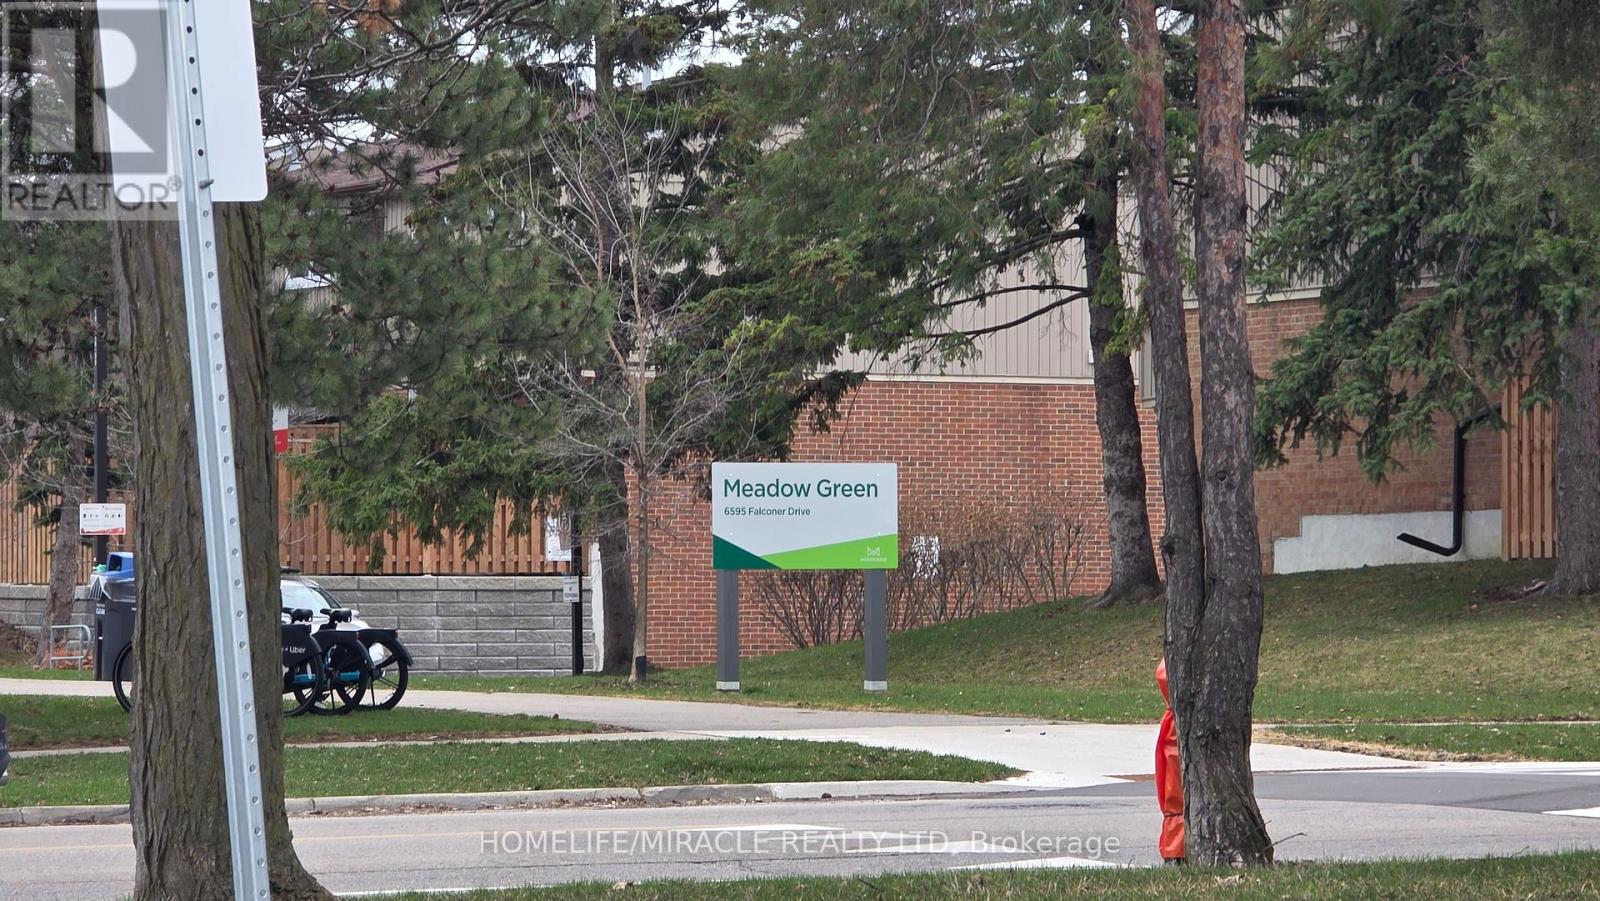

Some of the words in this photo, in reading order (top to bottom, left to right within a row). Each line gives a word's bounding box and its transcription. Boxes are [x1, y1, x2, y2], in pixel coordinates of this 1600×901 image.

[723, 478, 812, 498] Meadow
[817, 478, 878, 498] Green
[724, 507, 747, 516] 6595
[748, 506, 786, 516] Falconer
[788, 507, 811, 516] Drive
[289, 645, 306, 654] Uber
